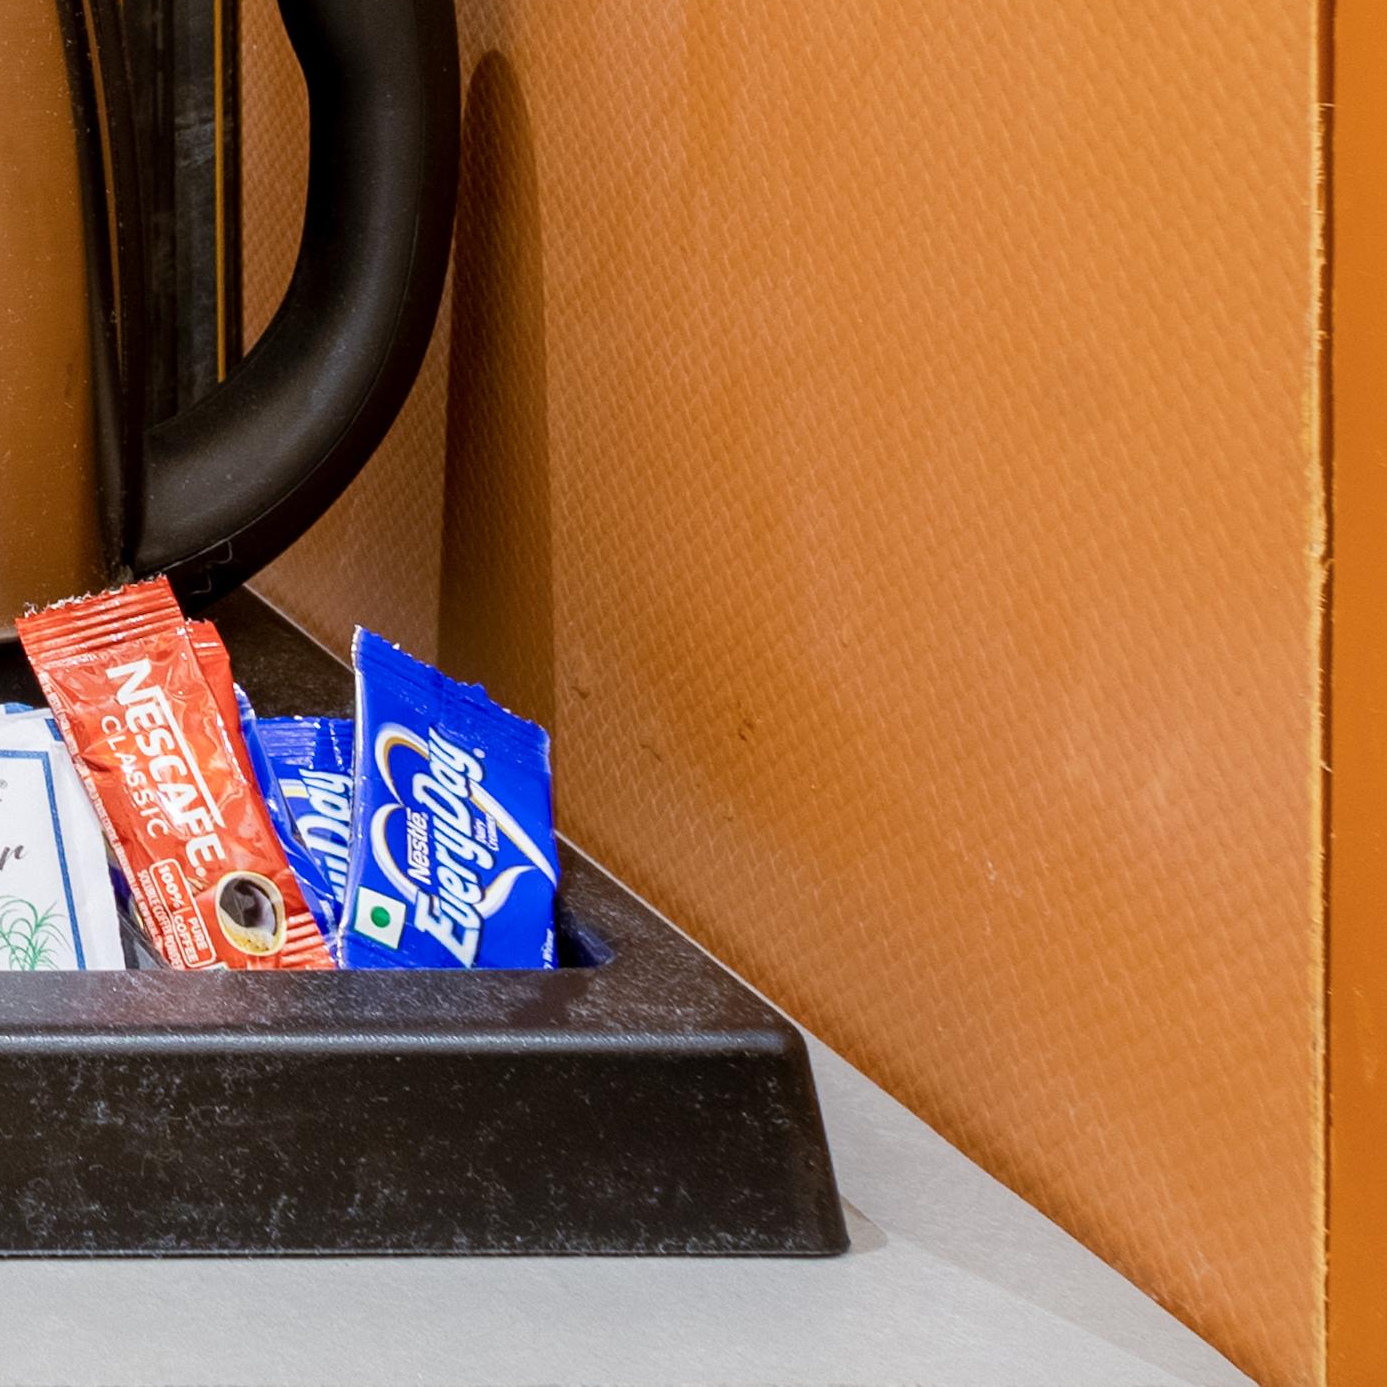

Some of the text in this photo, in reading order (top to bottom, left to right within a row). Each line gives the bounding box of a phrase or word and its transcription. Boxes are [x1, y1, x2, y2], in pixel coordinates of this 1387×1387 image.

[100, 715, 168, 838] CLASSIC
[412, 727, 495, 969] EveryDay
[160, 871, 183, 910] 100%
[174, 915, 198, 964] COFFEE
[187, 916, 209, 950] PURE
